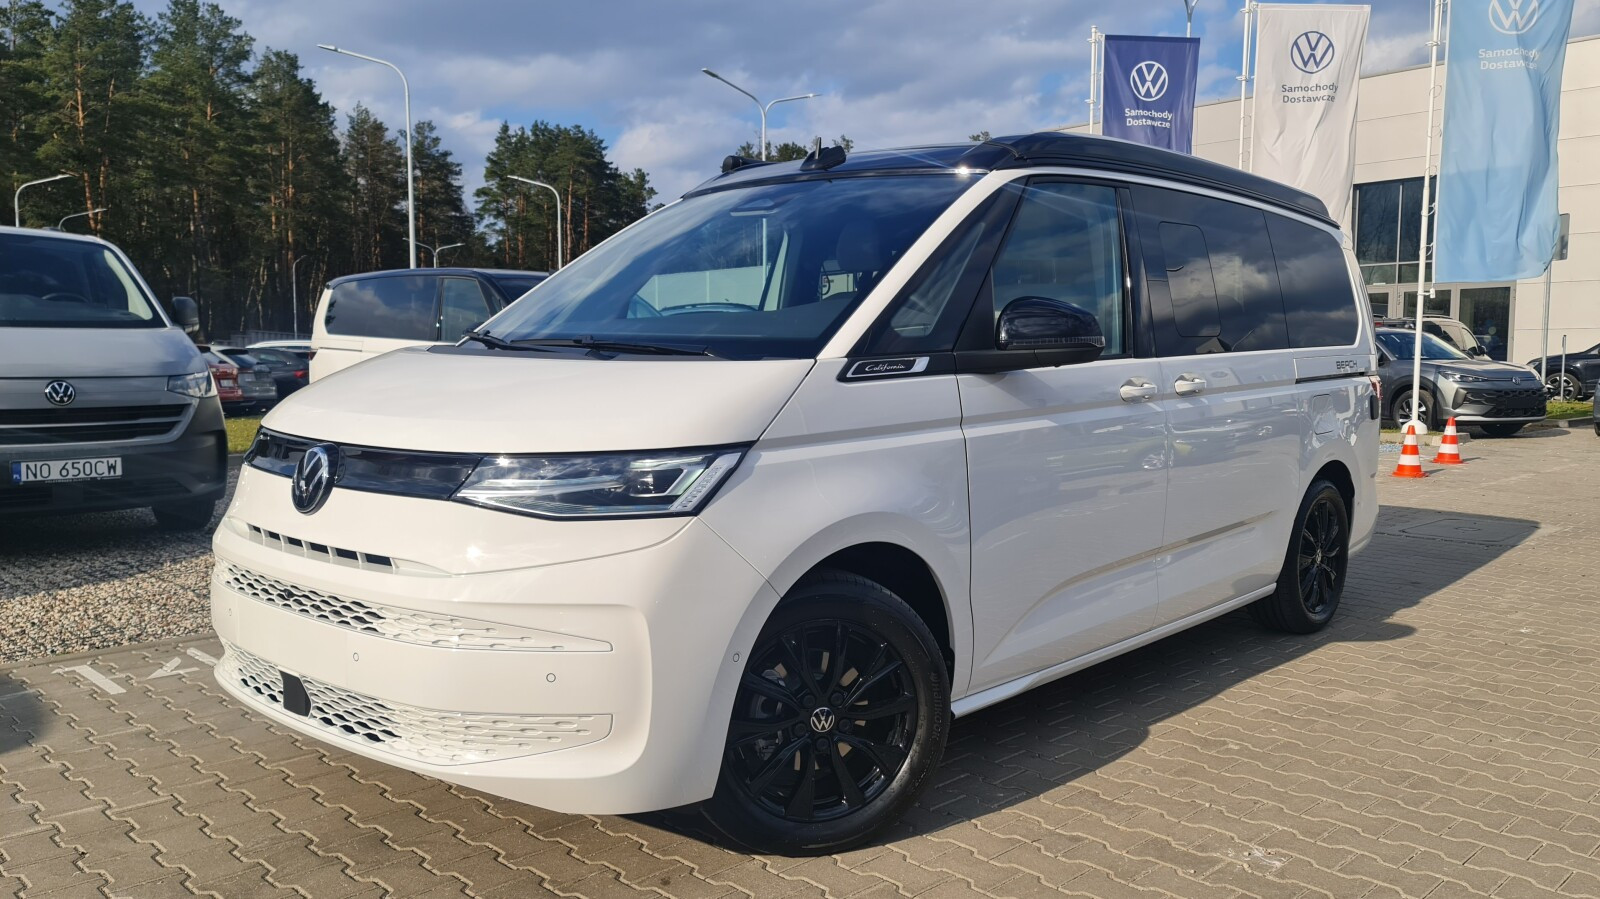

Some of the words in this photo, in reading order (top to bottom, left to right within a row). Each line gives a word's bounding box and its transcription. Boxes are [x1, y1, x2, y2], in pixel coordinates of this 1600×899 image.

[1291, 31, 1334, 74] VW
[1479, 48, 1539, 60] Samochody
[1130, 61, 1168, 101] VW
[1281, 82, 1338, 93] Samochody
[1282, 95, 1335, 103] Dostawcze
[1125, 108, 1172, 120] Samochody
[1126, 118, 1171, 128] Dostawcze
[865, 363, 905, 371] California
[1336, 360, 1357, 369] BEACH
[26, 463, 51, 479] NO
[59, 460, 117, 477] 650CW
